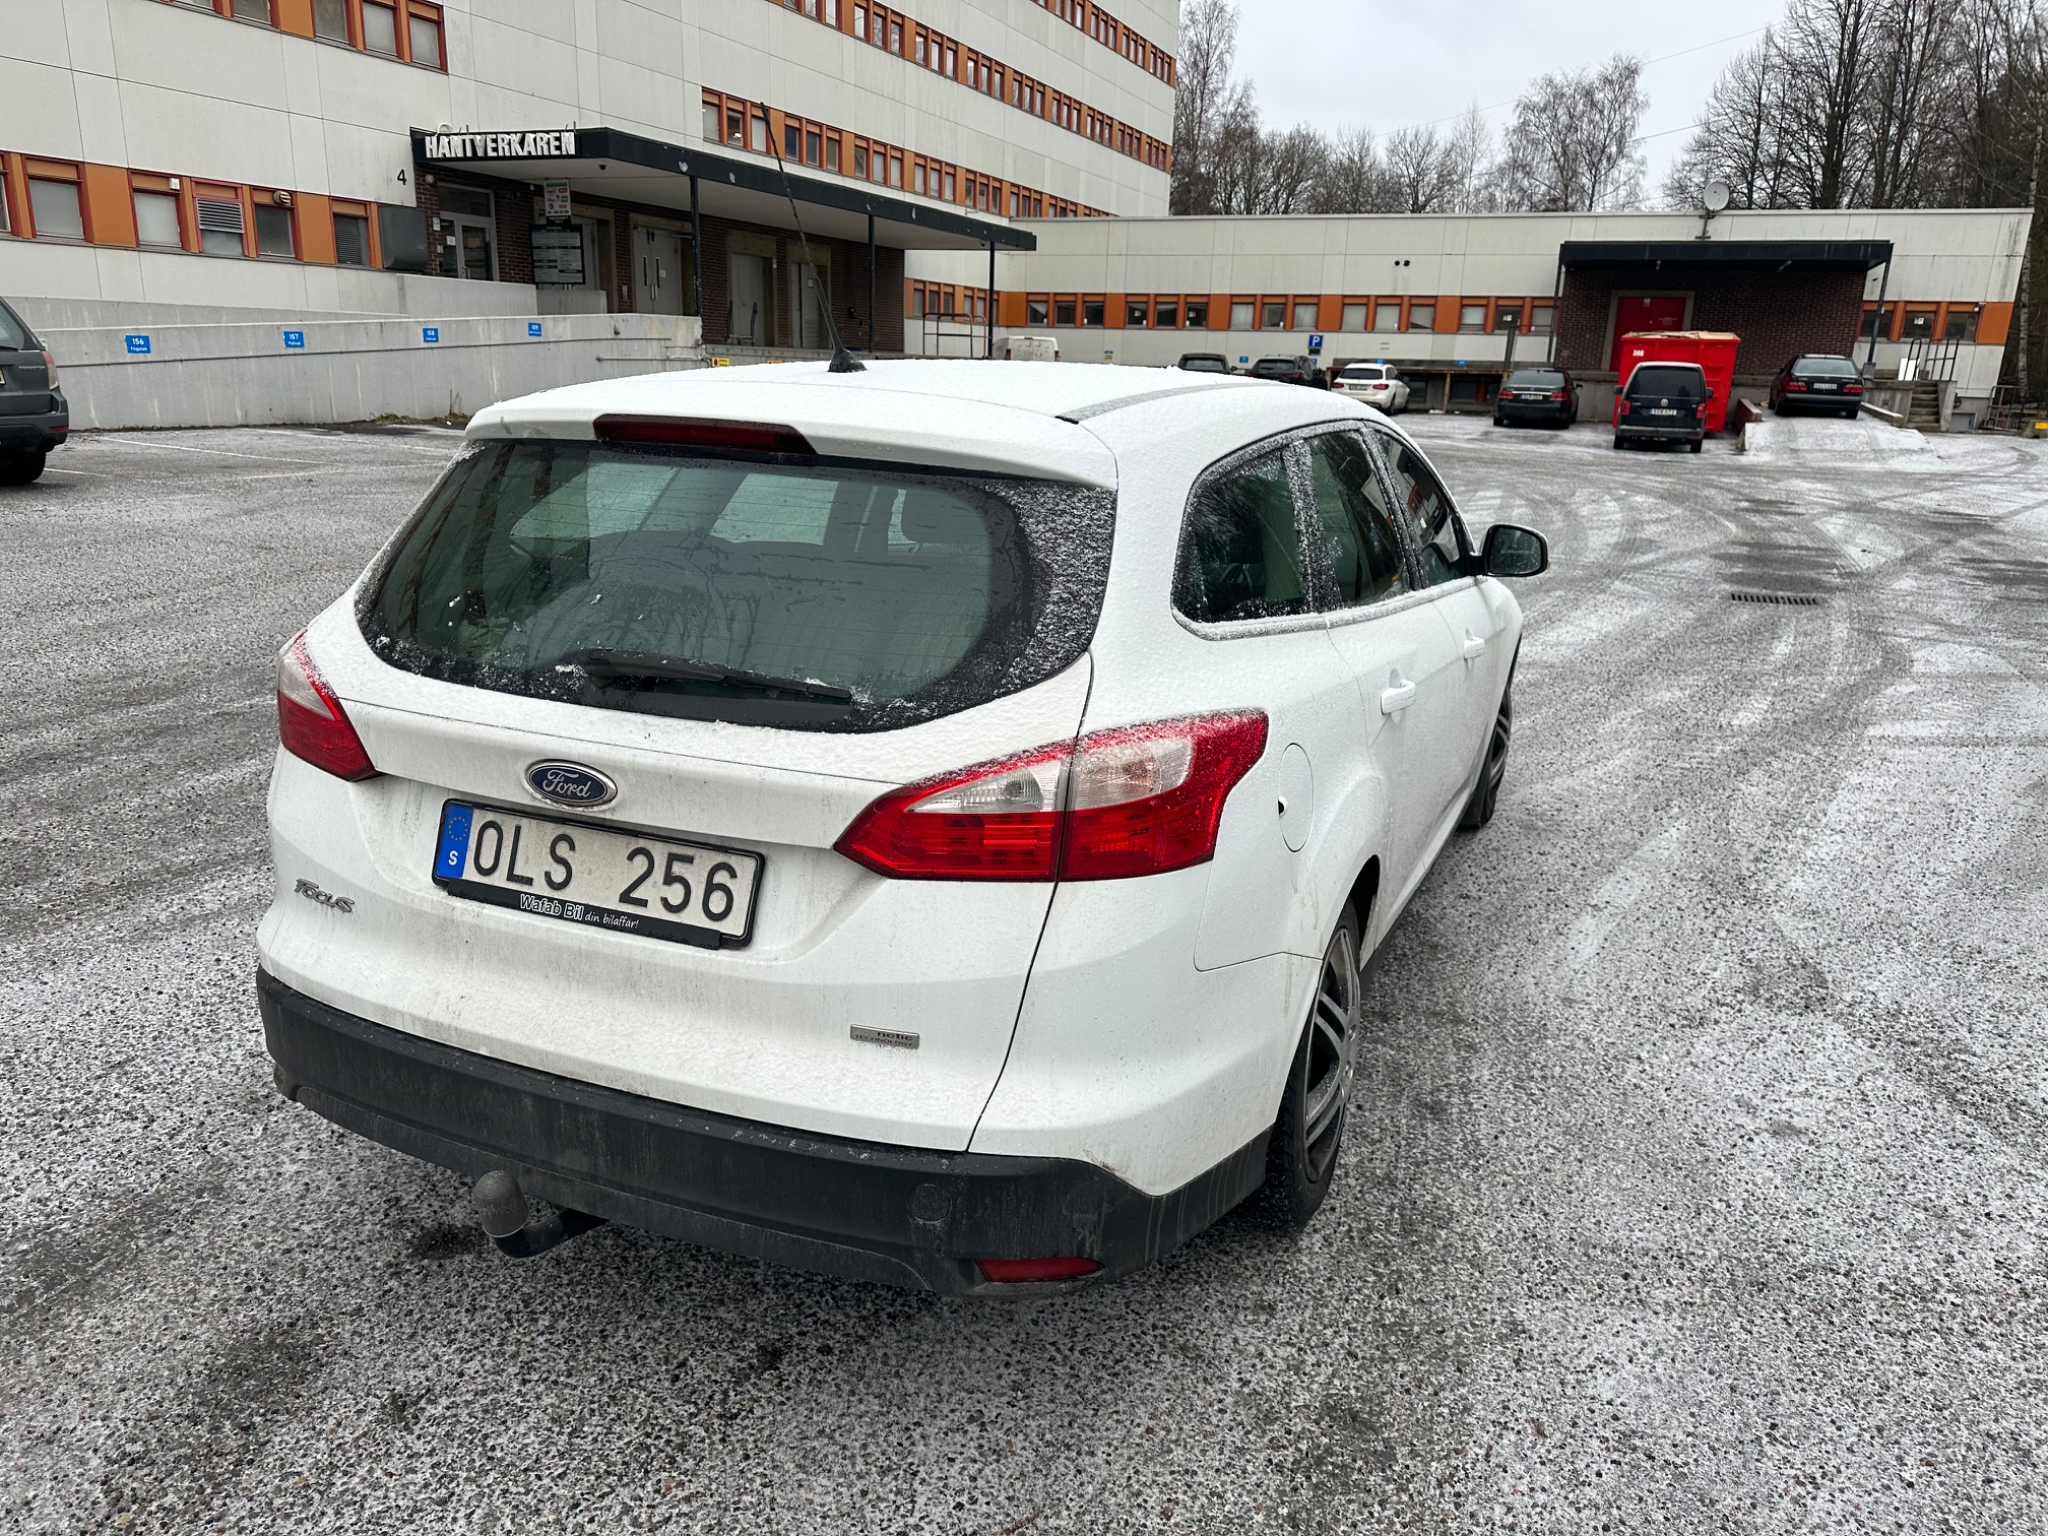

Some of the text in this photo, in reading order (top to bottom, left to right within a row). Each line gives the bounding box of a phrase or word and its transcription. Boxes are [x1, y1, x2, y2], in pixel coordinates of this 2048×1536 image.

[425, 132, 576, 159] HANTVERKAREN
[396, 168, 407, 185] 4
[132, 337, 145, 345] 156
[1311, 336, 1321, 346] P
[542, 769, 592, 798] Ford
[448, 850, 459, 866] S
[473, 820, 738, 922] OLS 256
[520, 894, 562, 915] Wafab
[563, 902, 584, 920] Bil
[585, 911, 600, 922] din
